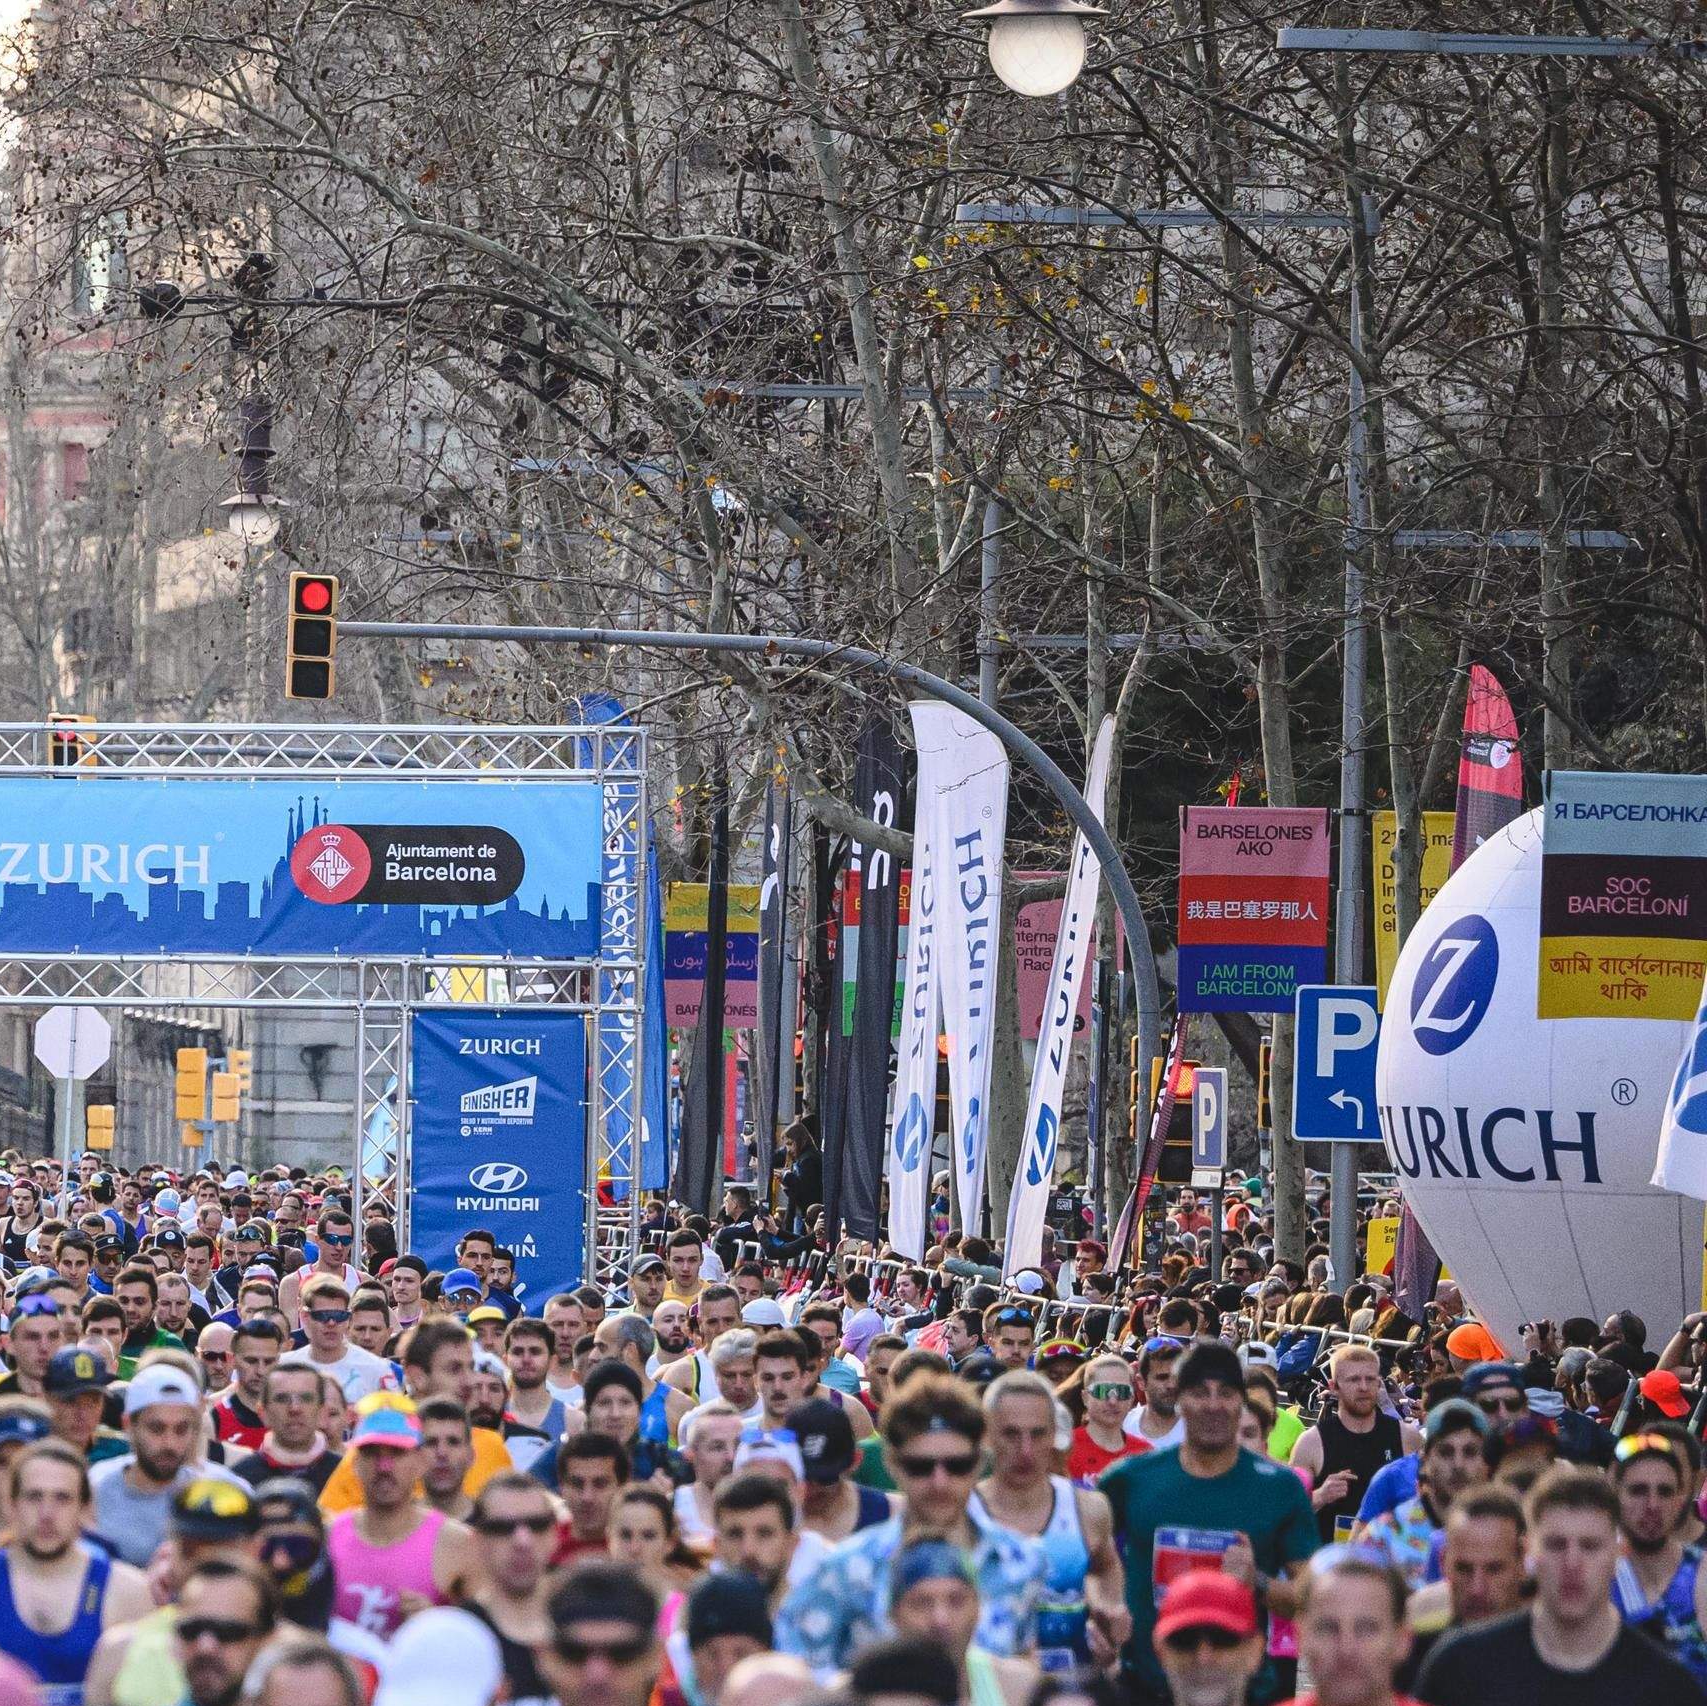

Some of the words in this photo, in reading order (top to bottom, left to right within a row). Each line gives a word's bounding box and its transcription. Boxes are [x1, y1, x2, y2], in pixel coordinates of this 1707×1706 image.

[1554, 803, 1568, 820] Я
[1197, 824, 1314, 841] BARSELONES
[385, 843, 475, 861] Ajuntament
[477, 844, 498, 859] de
[1235, 841, 1274, 857] AKO
[384, 862, 498, 882] Barcelona
[1606, 876, 1651, 896] SOC
[1186, 900, 1319, 921] 我是巴塞罗那人
[1567, 895, 1688, 917] BARCELONÍ
[1016, 945, 1053, 958] ontra
[1203, 964, 1207, 979] I
[1211, 964, 1238, 979] AM
[1243, 964, 1295, 980] FROM
[1196, 981, 1298, 997] BARCELONA
[1316, 998, 1378, 1077] P
[458, 1038, 541, 1056] ZURICH
[463, 1085, 530, 1111] FINISHER
[1198, 1082, 1217, 1156] P
[1380, 1105, 1603, 1184] URICH
[456, 1197, 540, 1211] HYUNDAI
